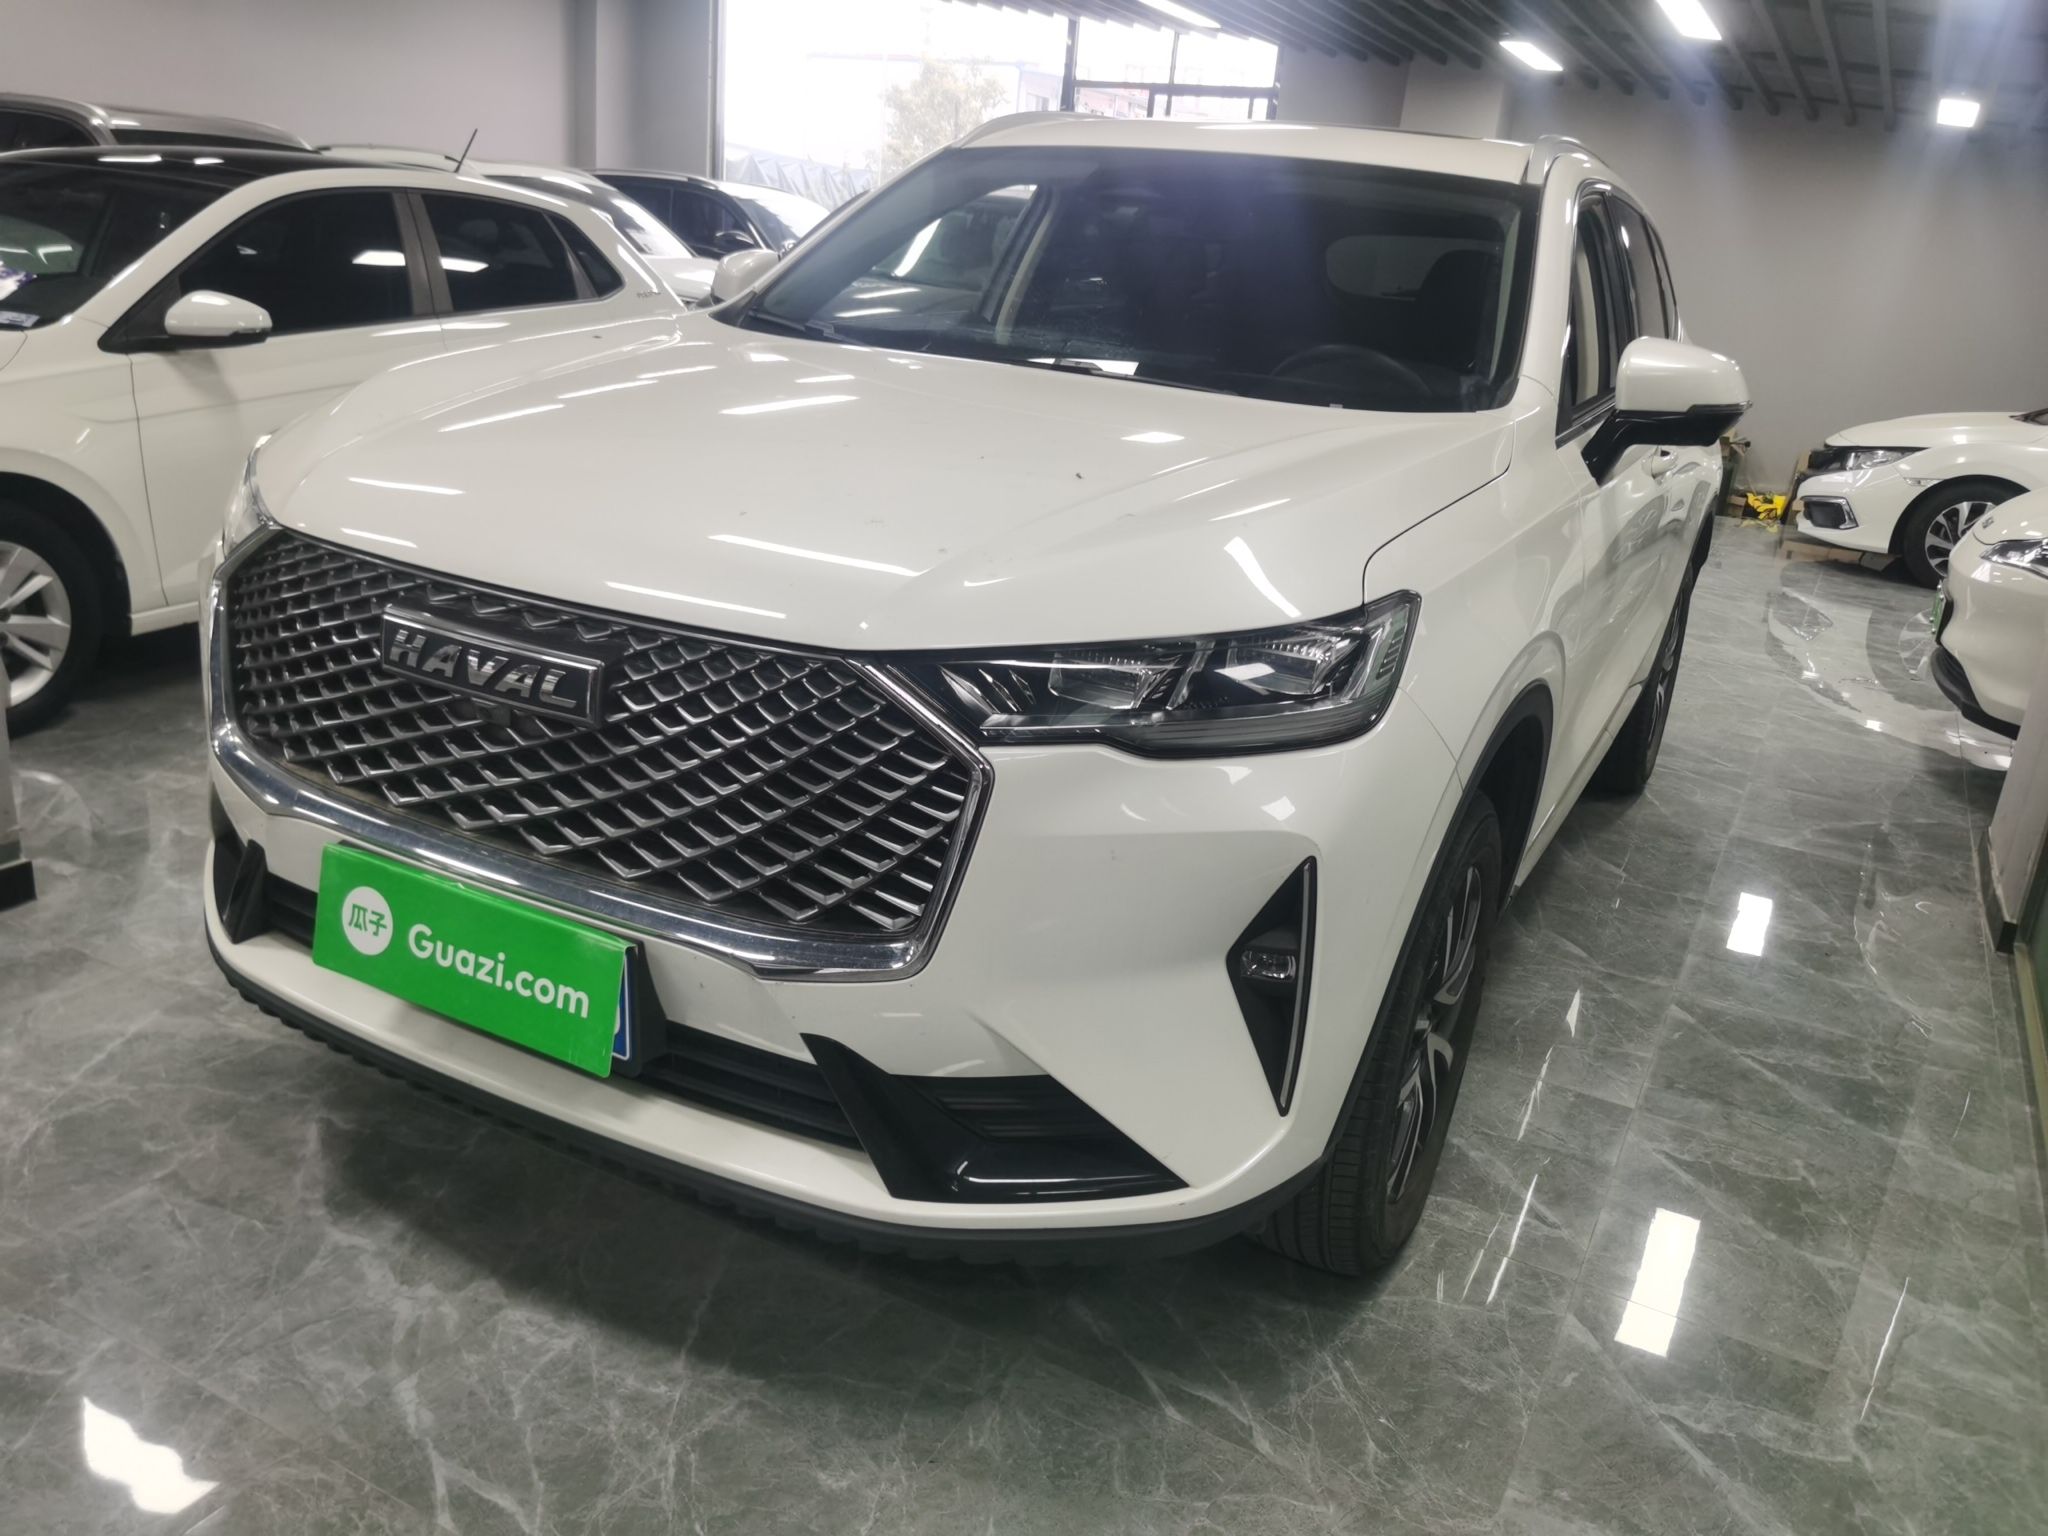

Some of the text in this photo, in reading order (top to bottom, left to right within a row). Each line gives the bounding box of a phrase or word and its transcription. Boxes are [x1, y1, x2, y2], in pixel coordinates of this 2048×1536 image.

[389, 629, 577, 709] HAVAL
[348, 903, 388, 937] 瓜子
[408, 923, 590, 1019] Guazi.com
